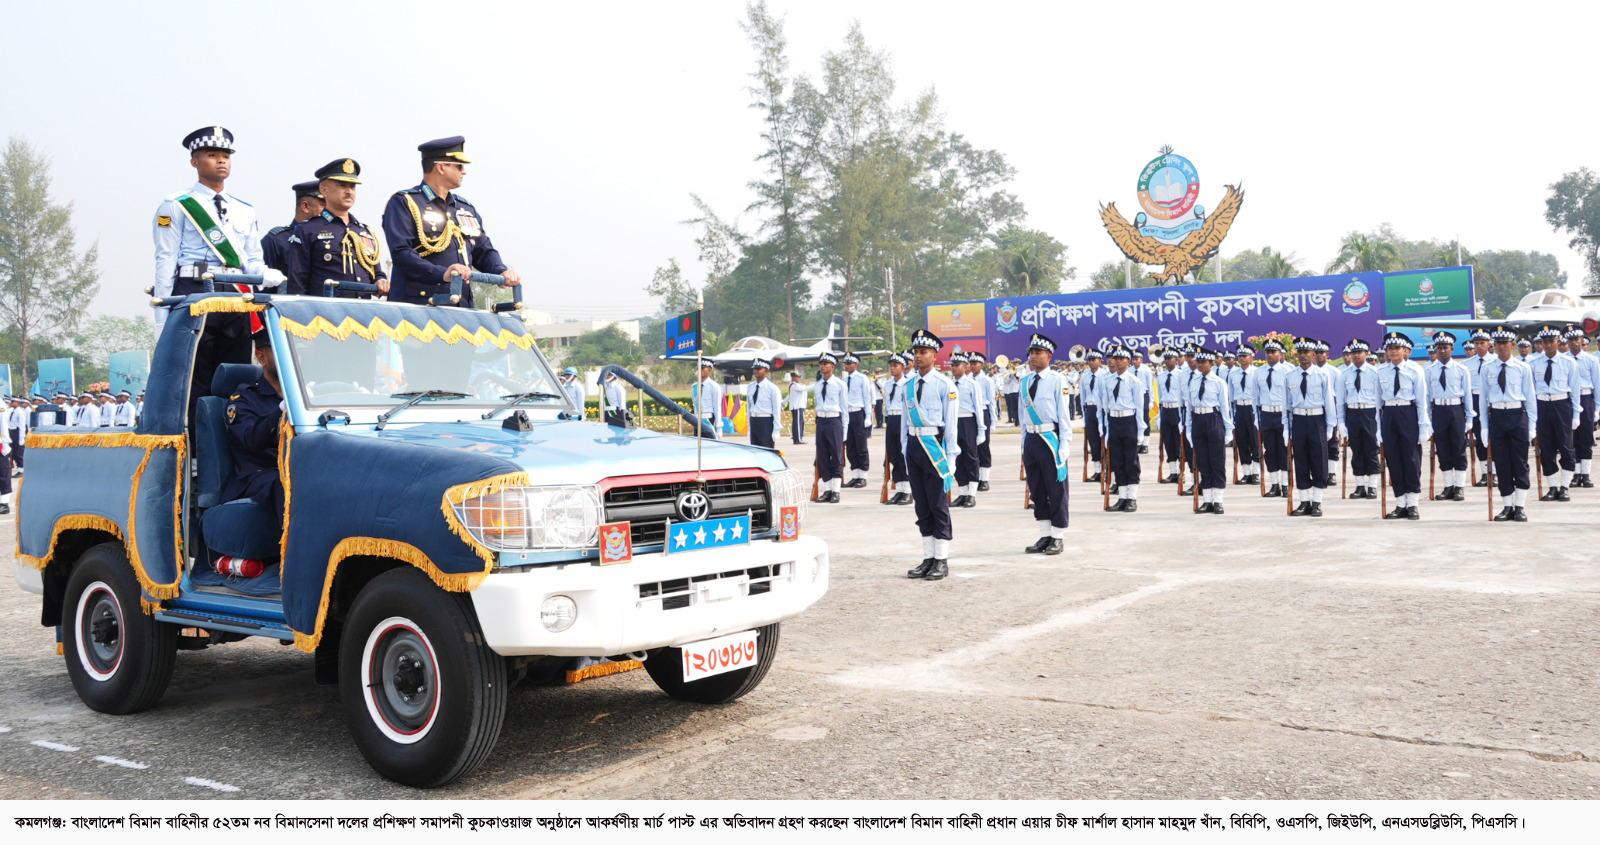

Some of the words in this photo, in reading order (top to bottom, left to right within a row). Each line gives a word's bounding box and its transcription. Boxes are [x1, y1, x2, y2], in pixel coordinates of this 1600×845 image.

[1021, 299, 1098, 329] প্রশিক্ষণ
[1103, 291, 1189, 323] সমাপনী
[1195, 288, 1335, 326] কুচকাওয়াজ
[1212, 330, 1244, 348] দল
